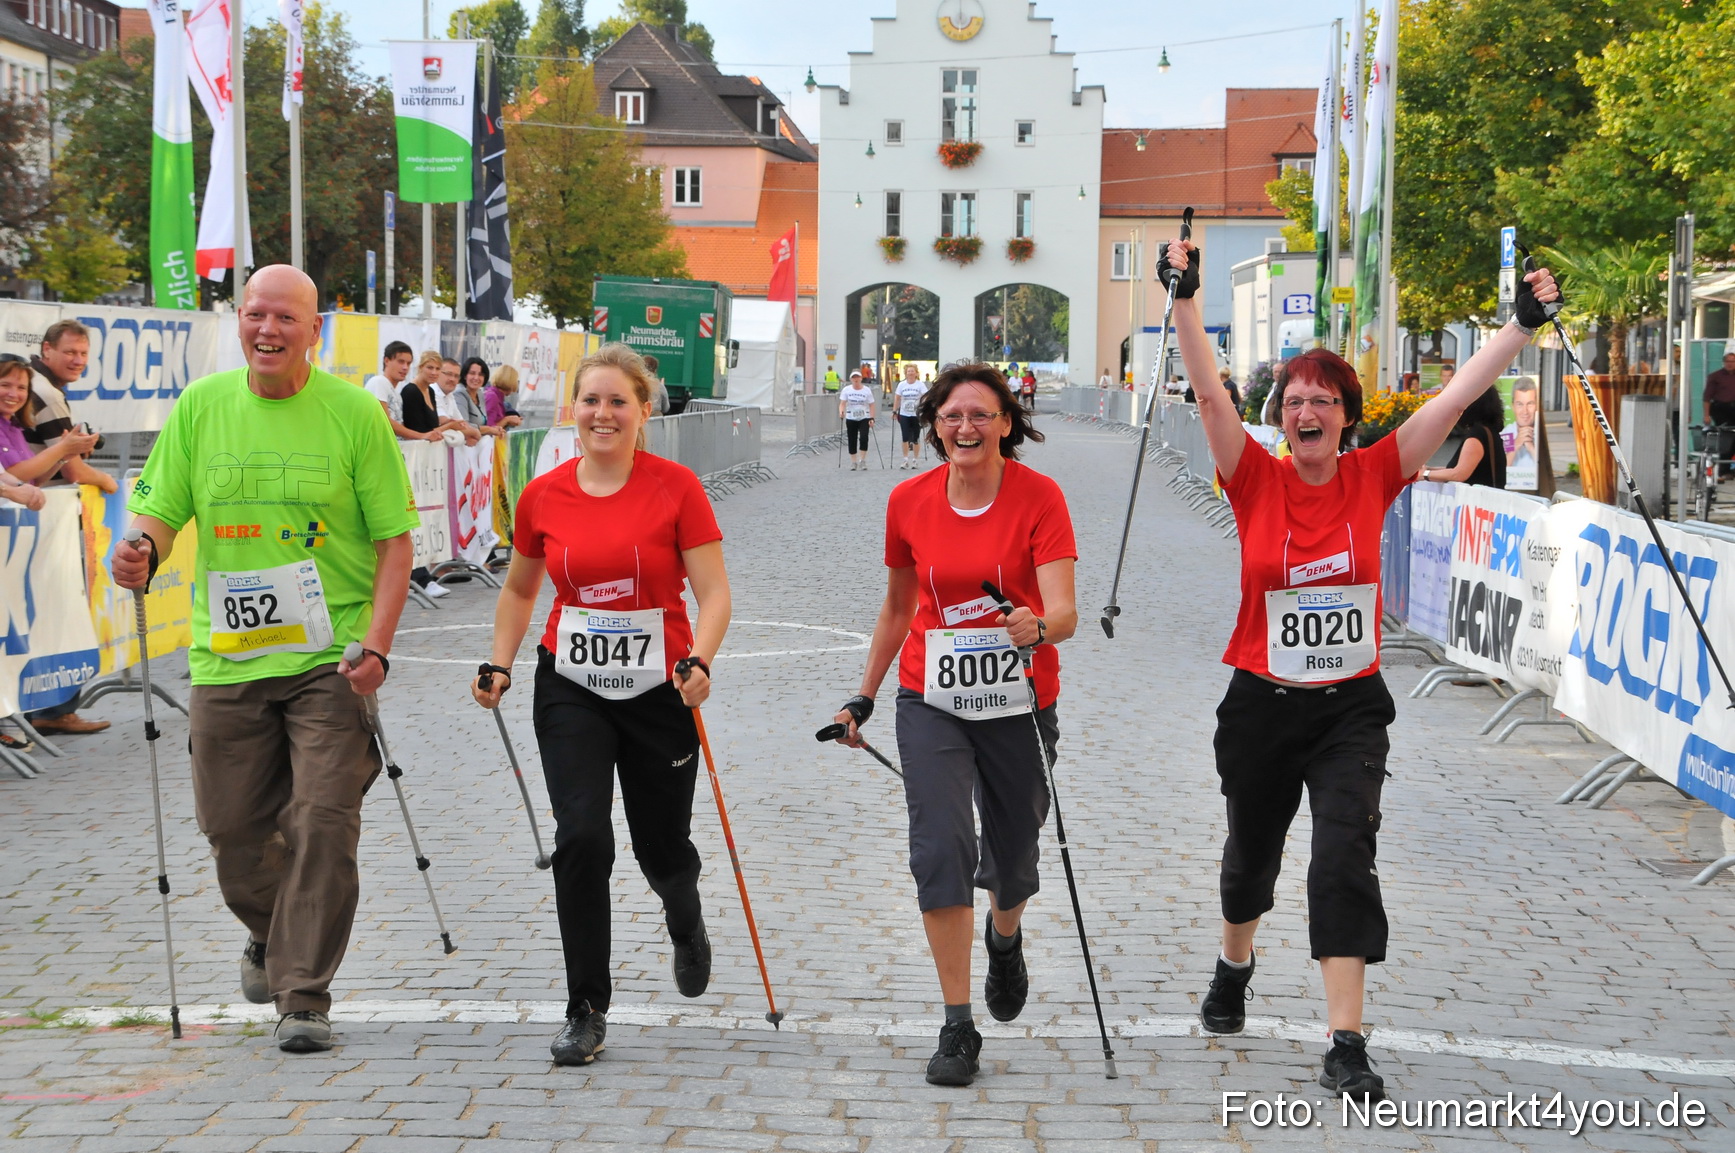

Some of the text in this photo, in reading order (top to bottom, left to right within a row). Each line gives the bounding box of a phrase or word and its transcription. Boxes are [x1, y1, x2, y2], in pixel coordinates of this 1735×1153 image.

[1503, 232, 1513, 258] P
[630, 326, 677, 337] Neumarkter
[621, 332, 684, 348] Lammsbräu
[65, 316, 193, 401] BOCK
[205, 451, 331, 499] OPF
[213, 524, 262, 539] MERZ
[1305, 562, 1334, 578] DEHN
[226, 575, 261, 587] BOCK
[593, 585, 618, 598] DEHN
[1297, 591, 1344, 605] BOCK
[223, 593, 283, 630] 852
[959, 602, 984, 617] DEHN
[587, 615, 632, 627] BOCK
[1280, 608, 1364, 648] 8020
[1568, 522, 1718, 726] BOCK
[239, 631, 287, 648] Michael
[954, 633, 999, 646] BOCK
[569, 631, 652, 667] 8047
[937, 649, 1020, 690] 8002
[1306, 655, 1343, 670] Rosa
[587, 673, 634, 689] Nicole
[953, 693, 1008, 712] Brigitte
